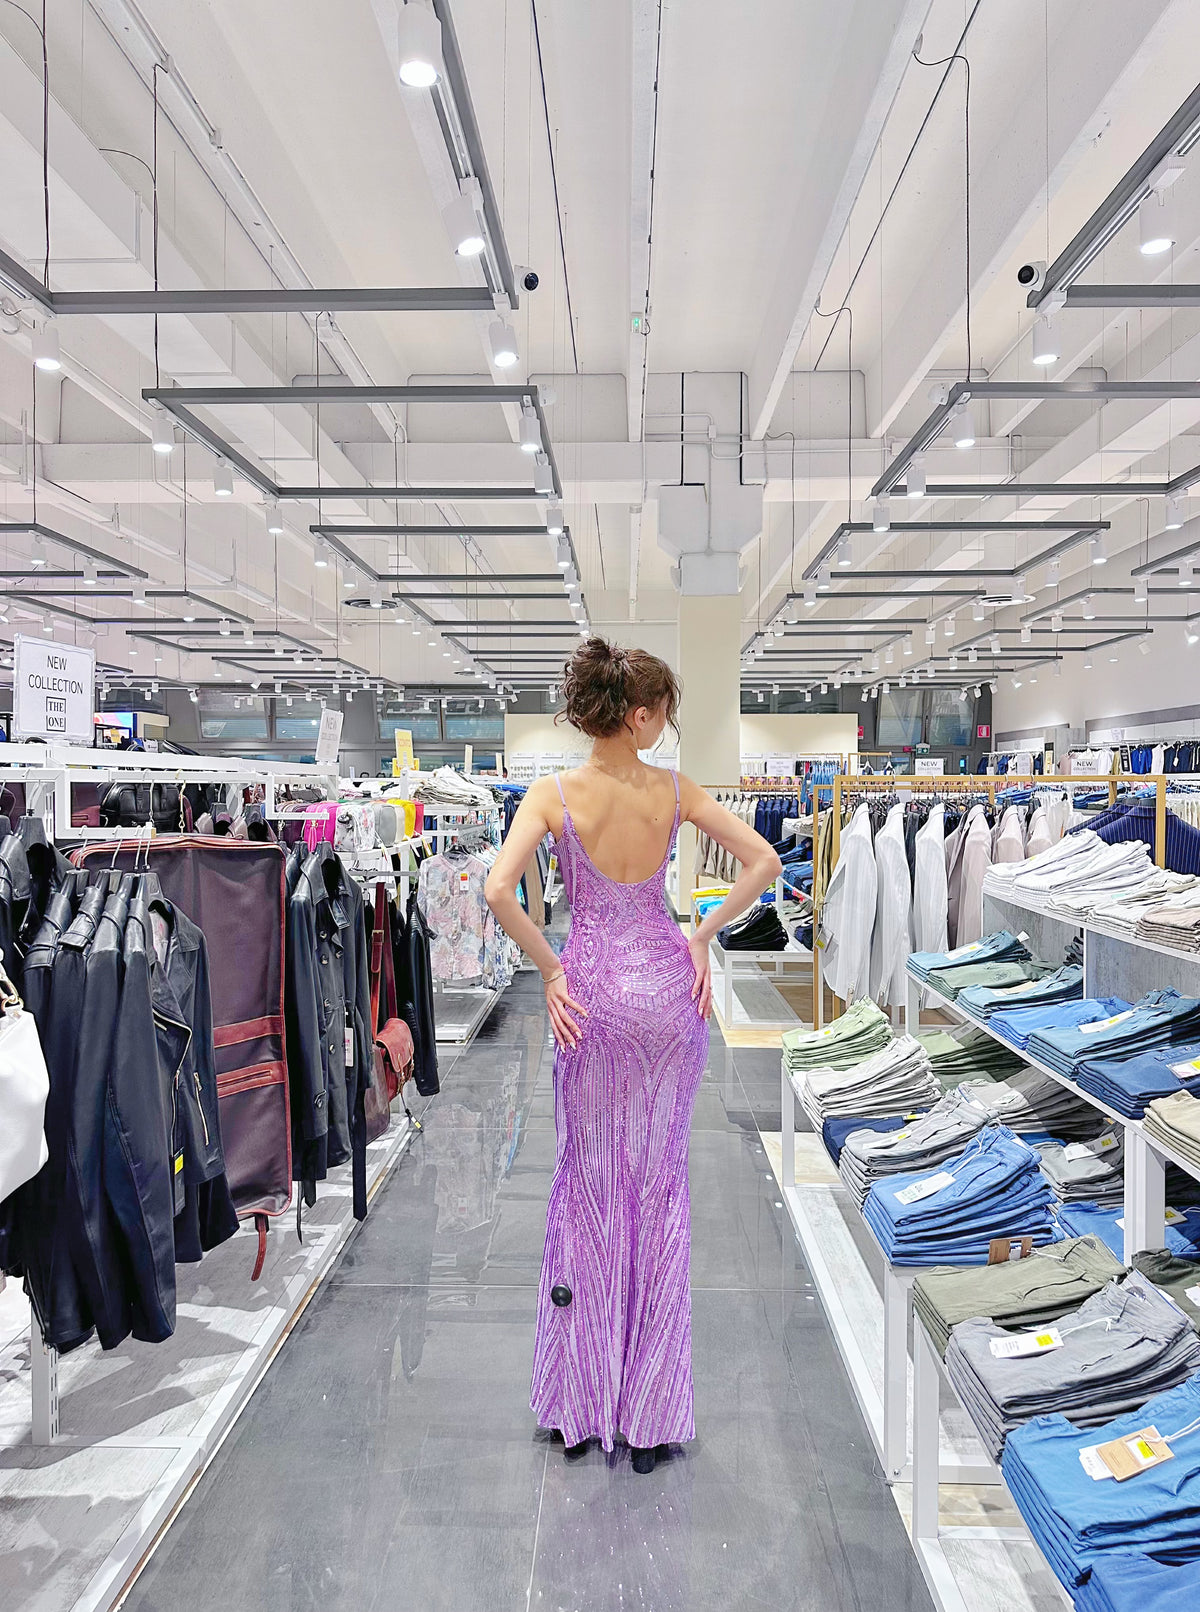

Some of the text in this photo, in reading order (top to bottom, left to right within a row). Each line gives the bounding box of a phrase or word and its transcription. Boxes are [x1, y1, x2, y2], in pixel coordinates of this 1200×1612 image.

[47, 655, 67, 670] NEW
[28, 674, 84, 694] COLLECTION
[48, 700, 64, 713] THE
[48, 716, 64, 728] ONE
